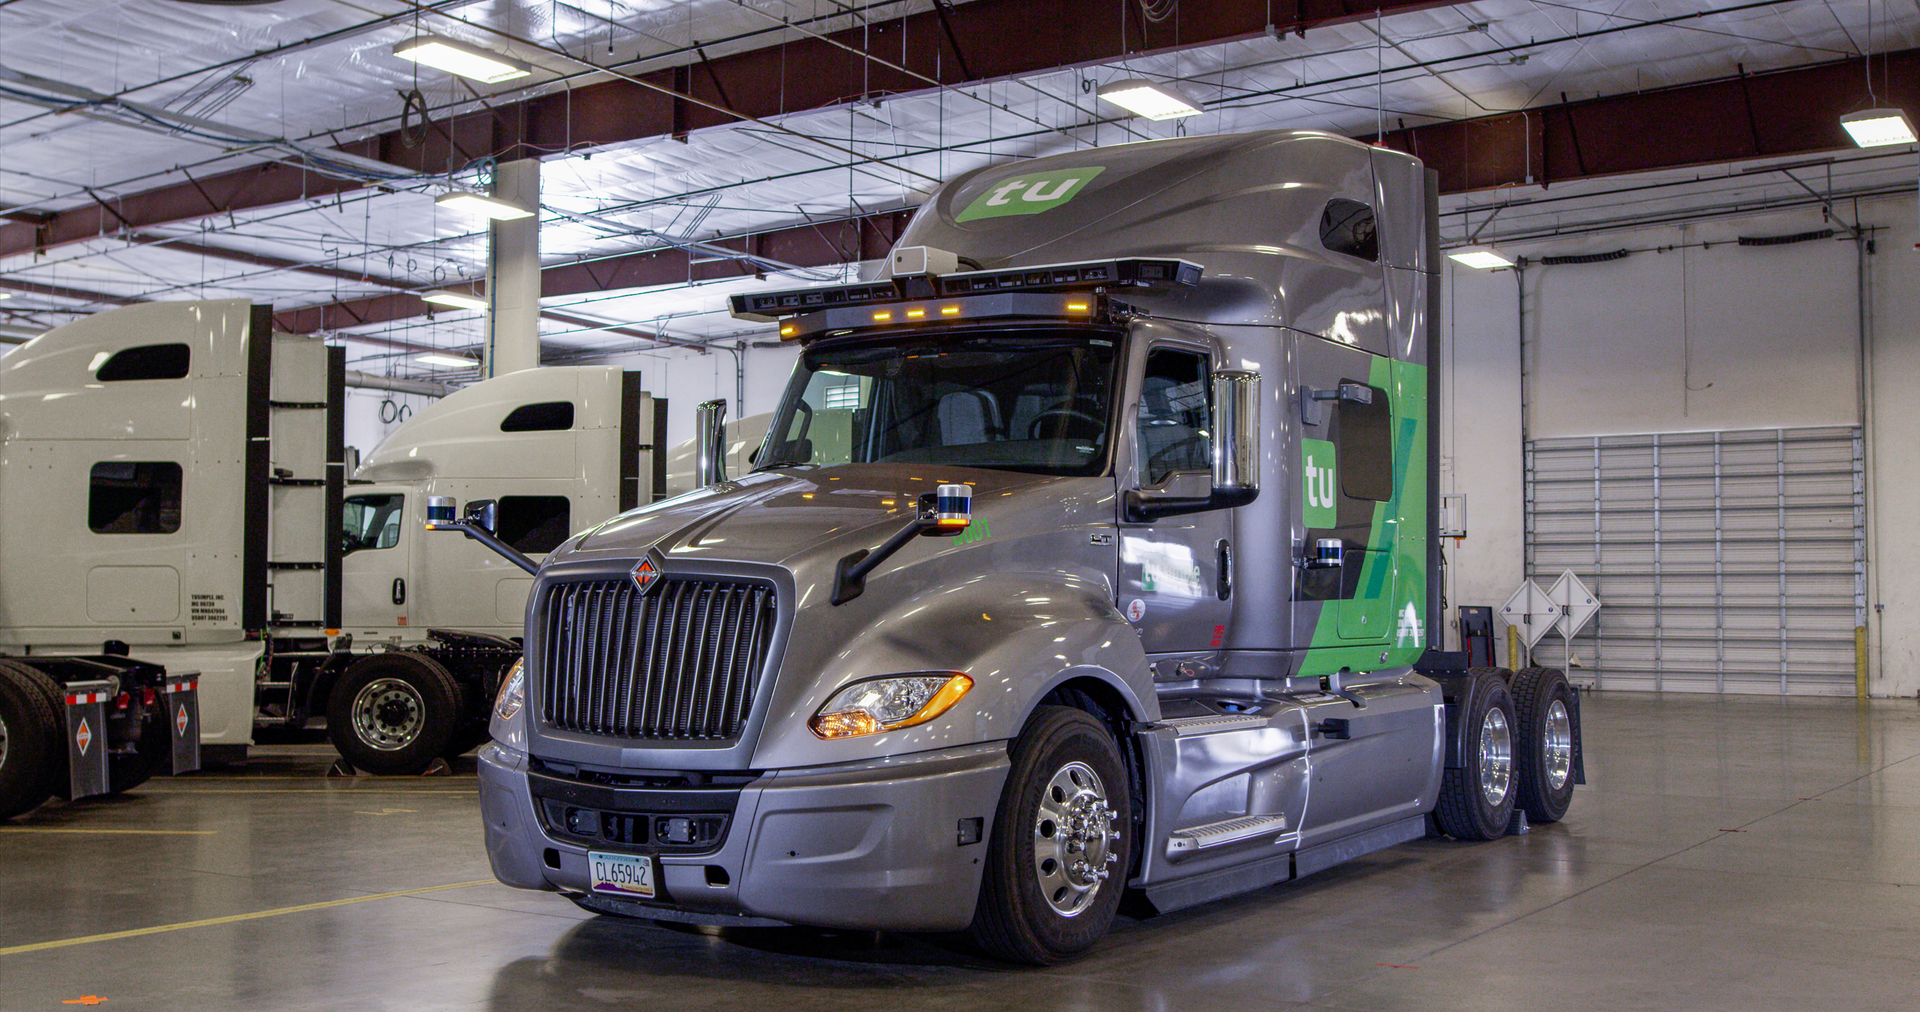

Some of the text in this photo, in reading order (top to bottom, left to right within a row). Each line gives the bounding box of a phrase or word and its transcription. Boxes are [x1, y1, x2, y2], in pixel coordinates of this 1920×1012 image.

[986, 178, 1080, 206] tu
[1305, 455, 1333, 509] tu
[596, 861, 647, 886] CL65942
